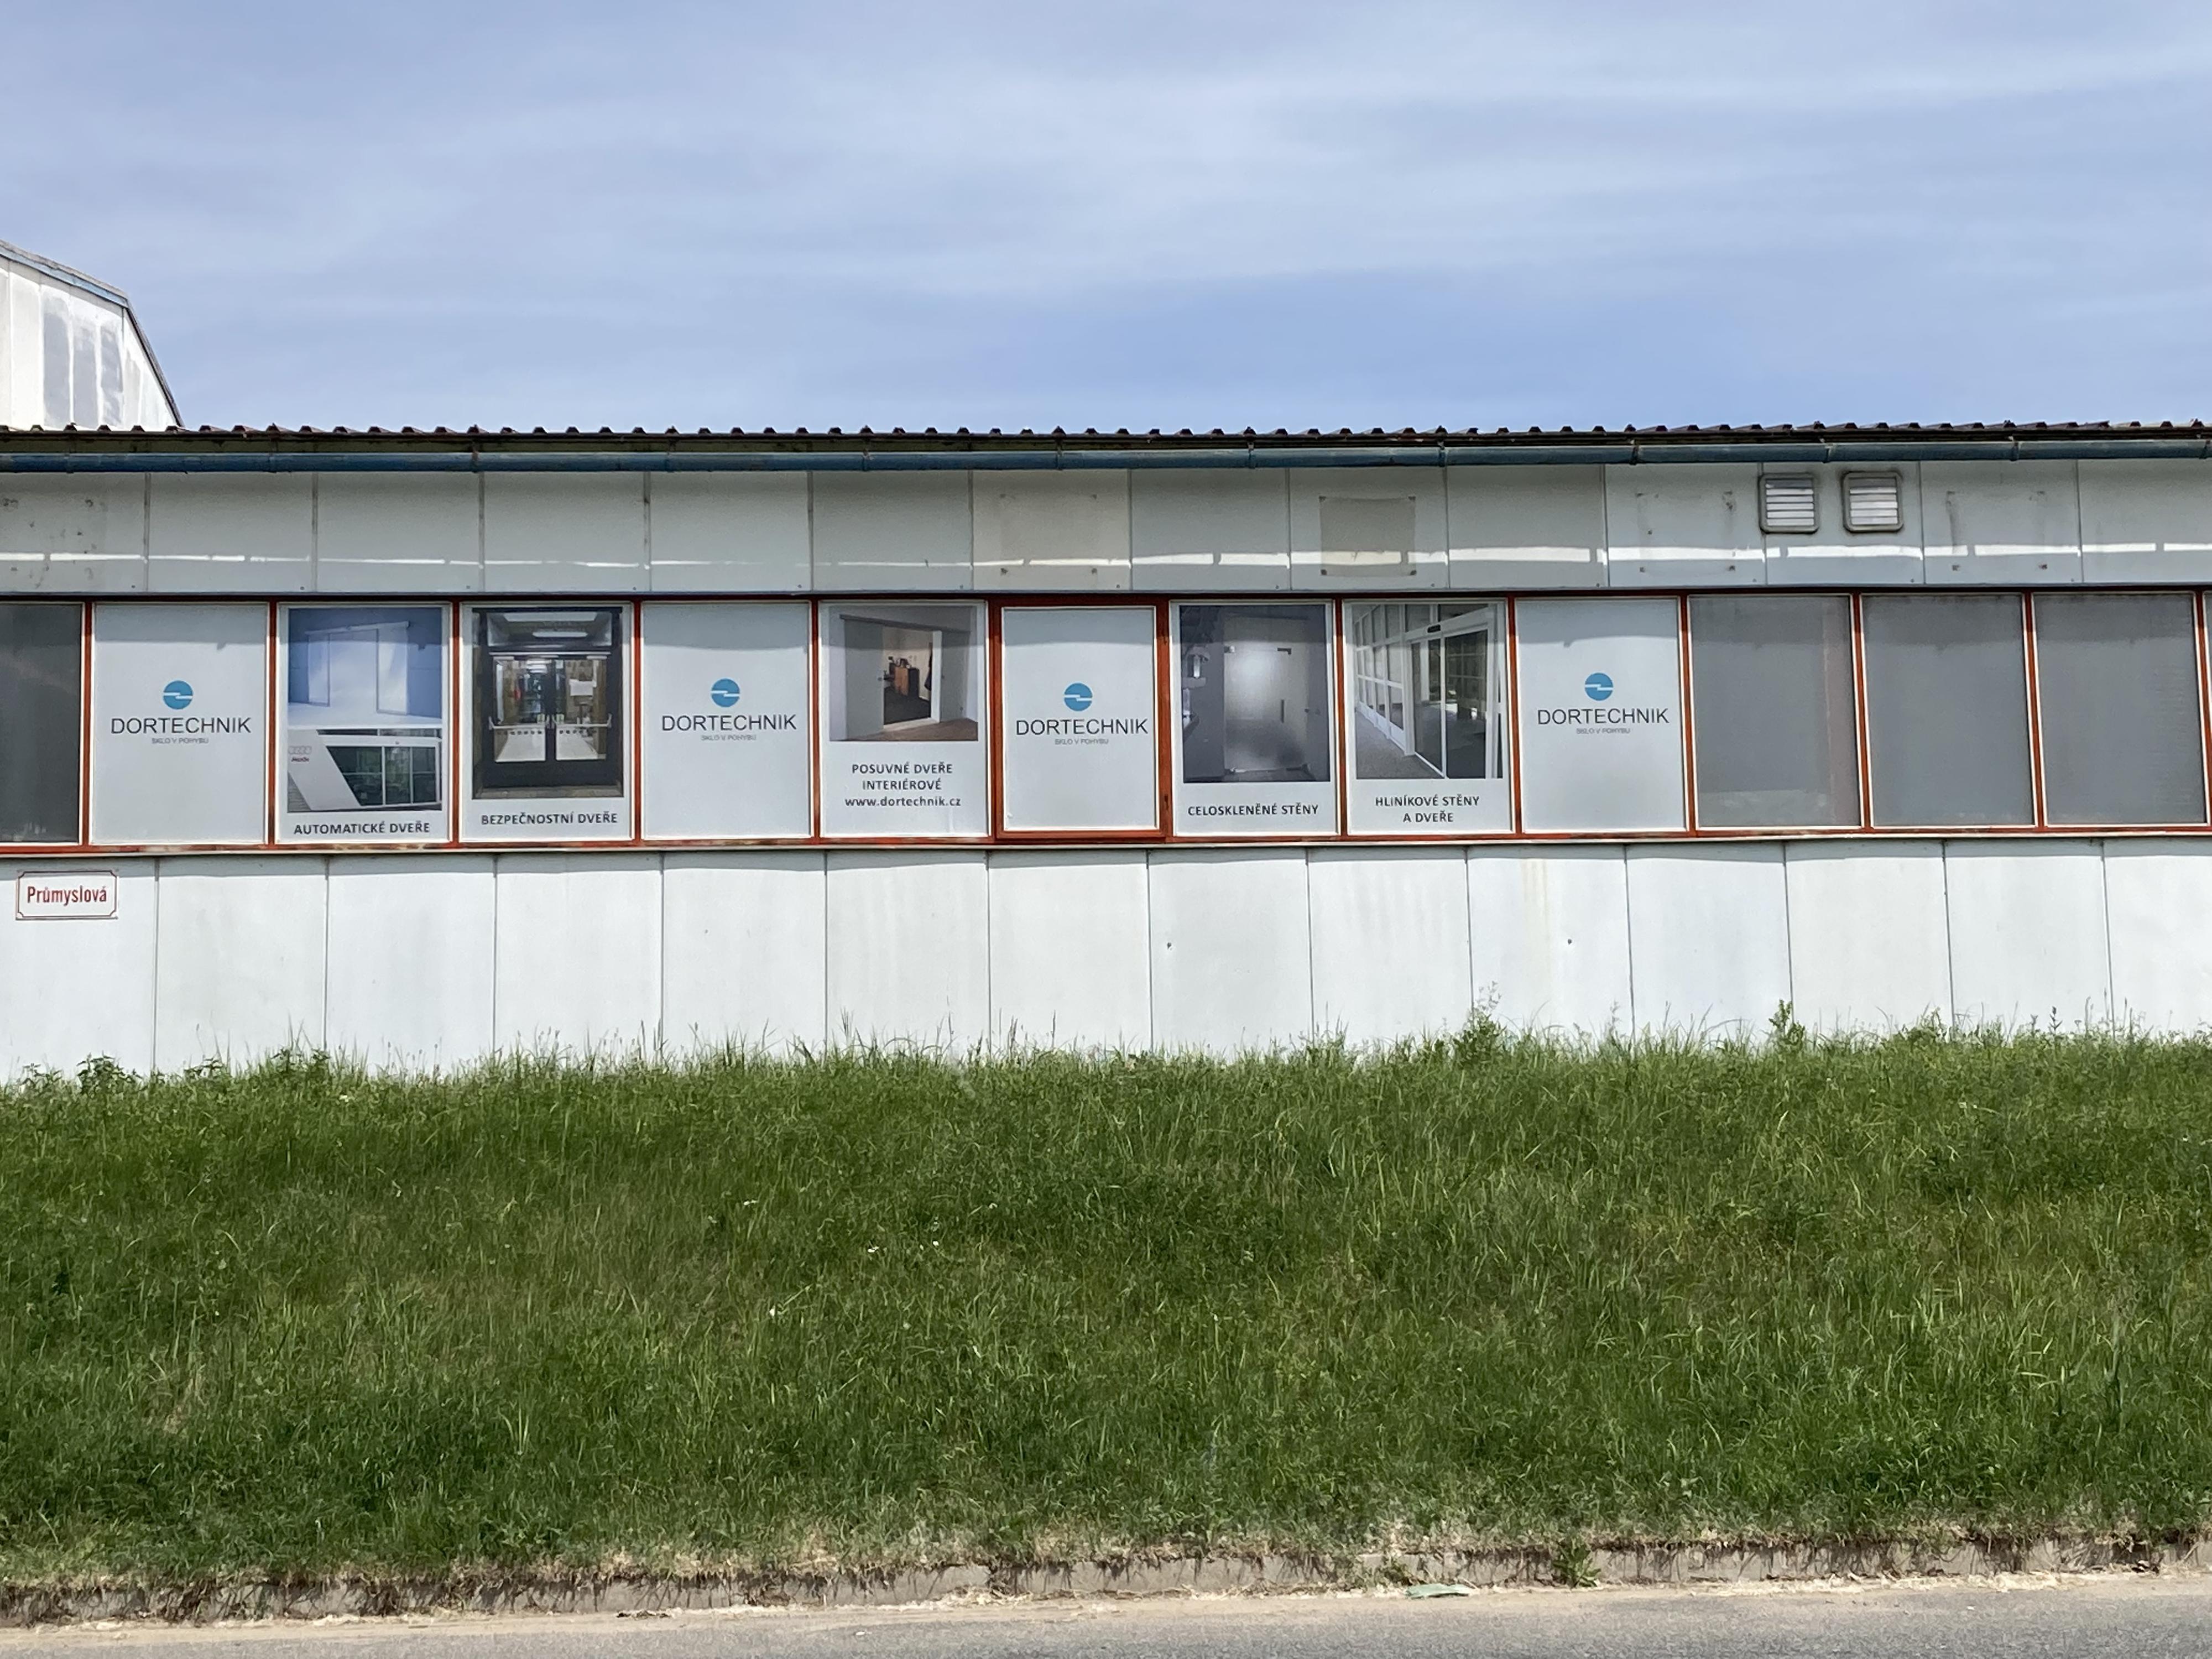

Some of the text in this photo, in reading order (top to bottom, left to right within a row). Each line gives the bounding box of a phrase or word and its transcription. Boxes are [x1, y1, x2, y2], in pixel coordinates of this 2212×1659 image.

[662, 714, 797, 731] DORTECHNIK
[1537, 708, 1670, 724] DORTECHNIK
[111, 717, 252, 734] DORTECHNIK
[1016, 718, 1149, 735] DORTECHNIK
[852, 761, 953, 774] POSUVNÉ DVEŘE
[863, 778, 942, 790] INTERIÉROVÉ
[845, 796, 961, 806] www.dortechnik.cz
[1375, 794, 1480, 806] HLINÍKOVÉ STĚNY
[1188, 802, 1318, 816] CELOSKLENĚNÉ STĚNY
[1403, 810, 1453, 822] A DVEŘE
[481, 811, 618, 825] BEZPEČNOSTNÍ DVEŘE
[294, 820, 430, 834] AUTOMATICKÉ DVEŘE
[27, 885, 107, 906] Průmyslová
